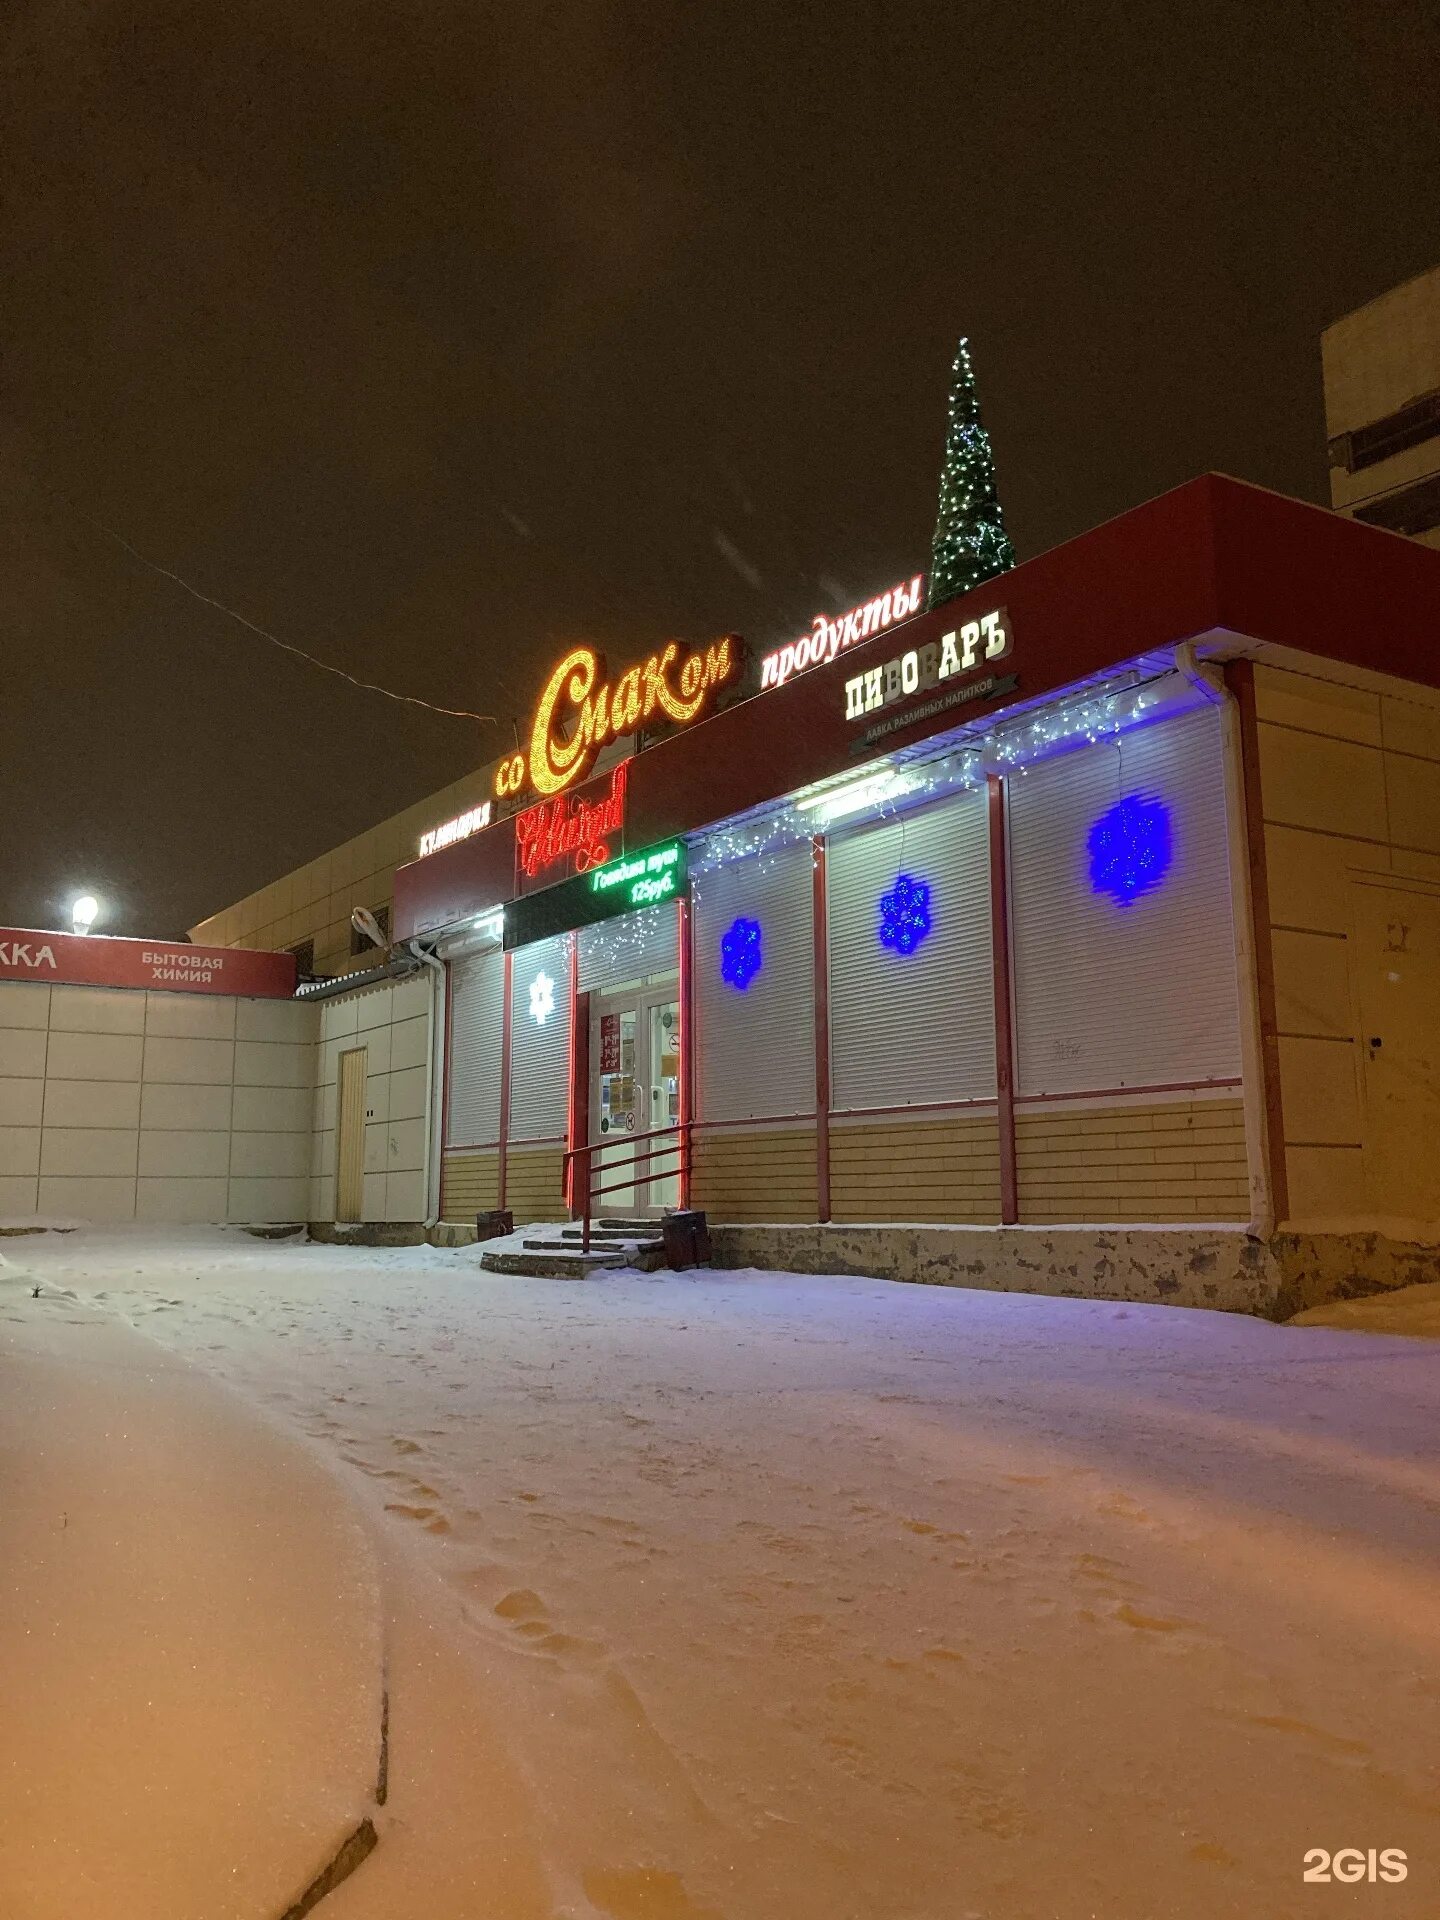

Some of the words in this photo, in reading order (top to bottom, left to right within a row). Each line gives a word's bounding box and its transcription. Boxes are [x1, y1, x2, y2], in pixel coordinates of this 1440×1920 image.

[761, 577, 922, 688] продукты
[845, 610, 1006, 721] ПИВОВАРЪ
[866, 722, 892, 741] ЛАВКА
[894, 700, 944, 729] РАЗЛИВНЫХ
[945, 678, 993, 707] НАПИТКОВ
[141, 951, 223, 970] БЫТОВАЯ
[152, 968, 213, 983] ХИМИЯ
